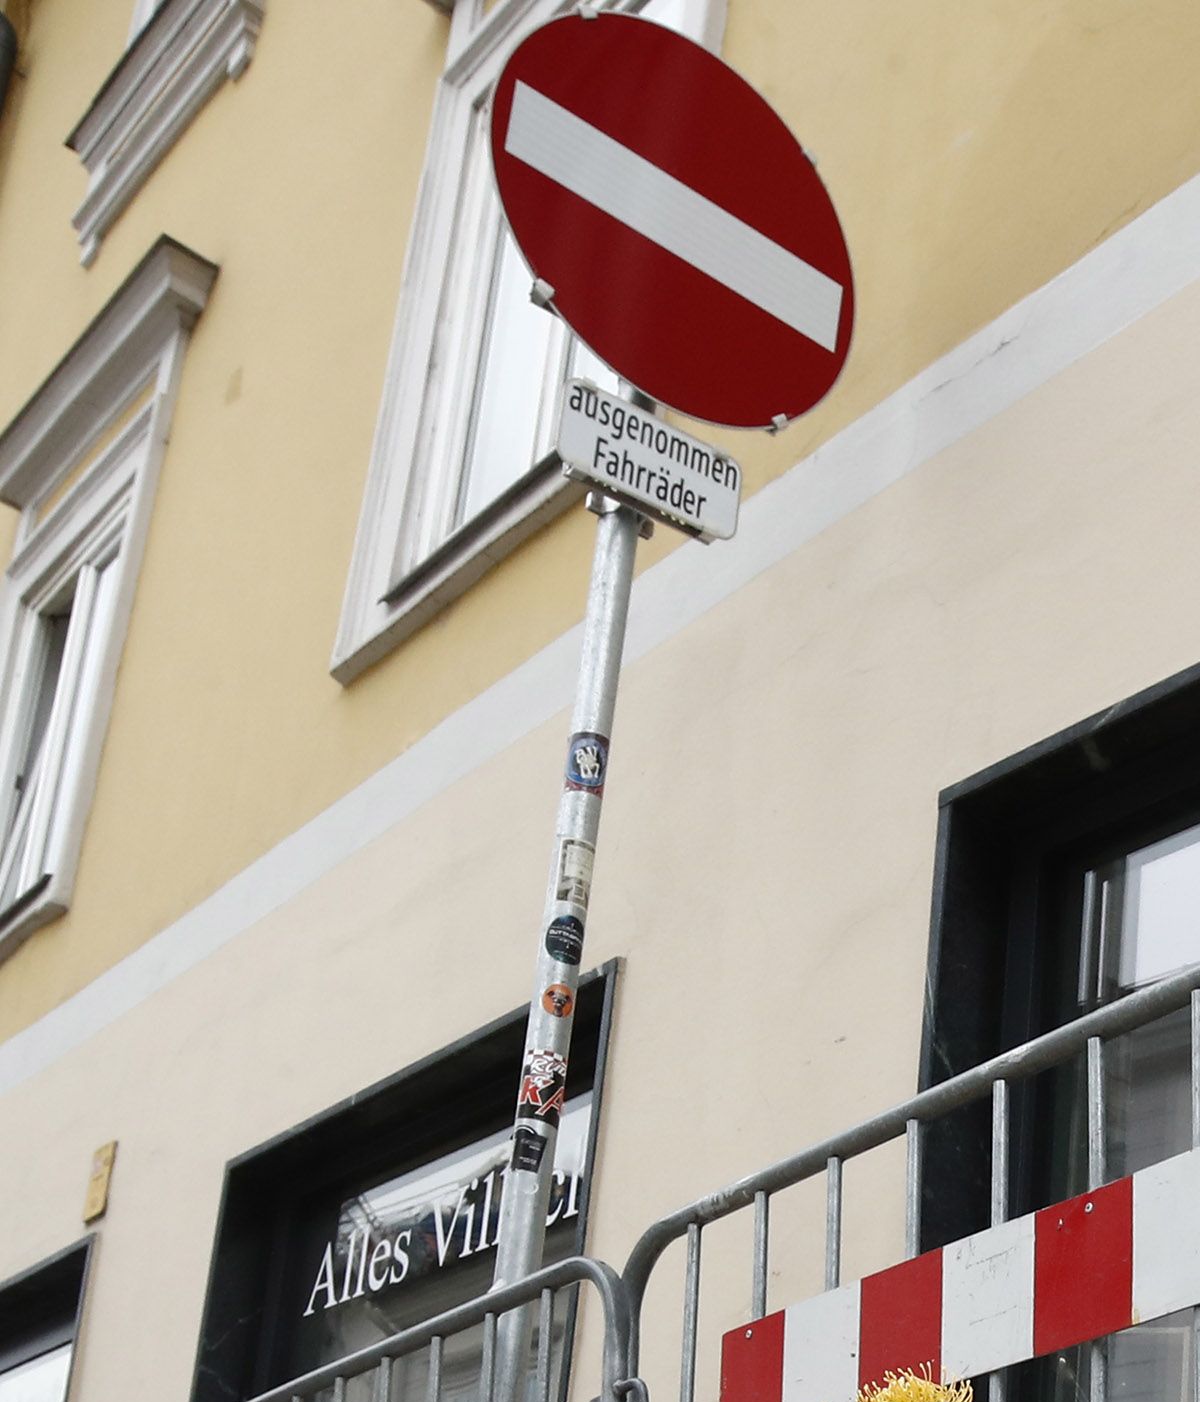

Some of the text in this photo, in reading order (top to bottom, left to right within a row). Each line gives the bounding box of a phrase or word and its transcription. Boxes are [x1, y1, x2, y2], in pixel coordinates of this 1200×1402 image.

[569, 385, 738, 491] ausgenommen
[593, 437, 707, 518] Fahrräder
[303, 1225, 412, 1317] Alles
